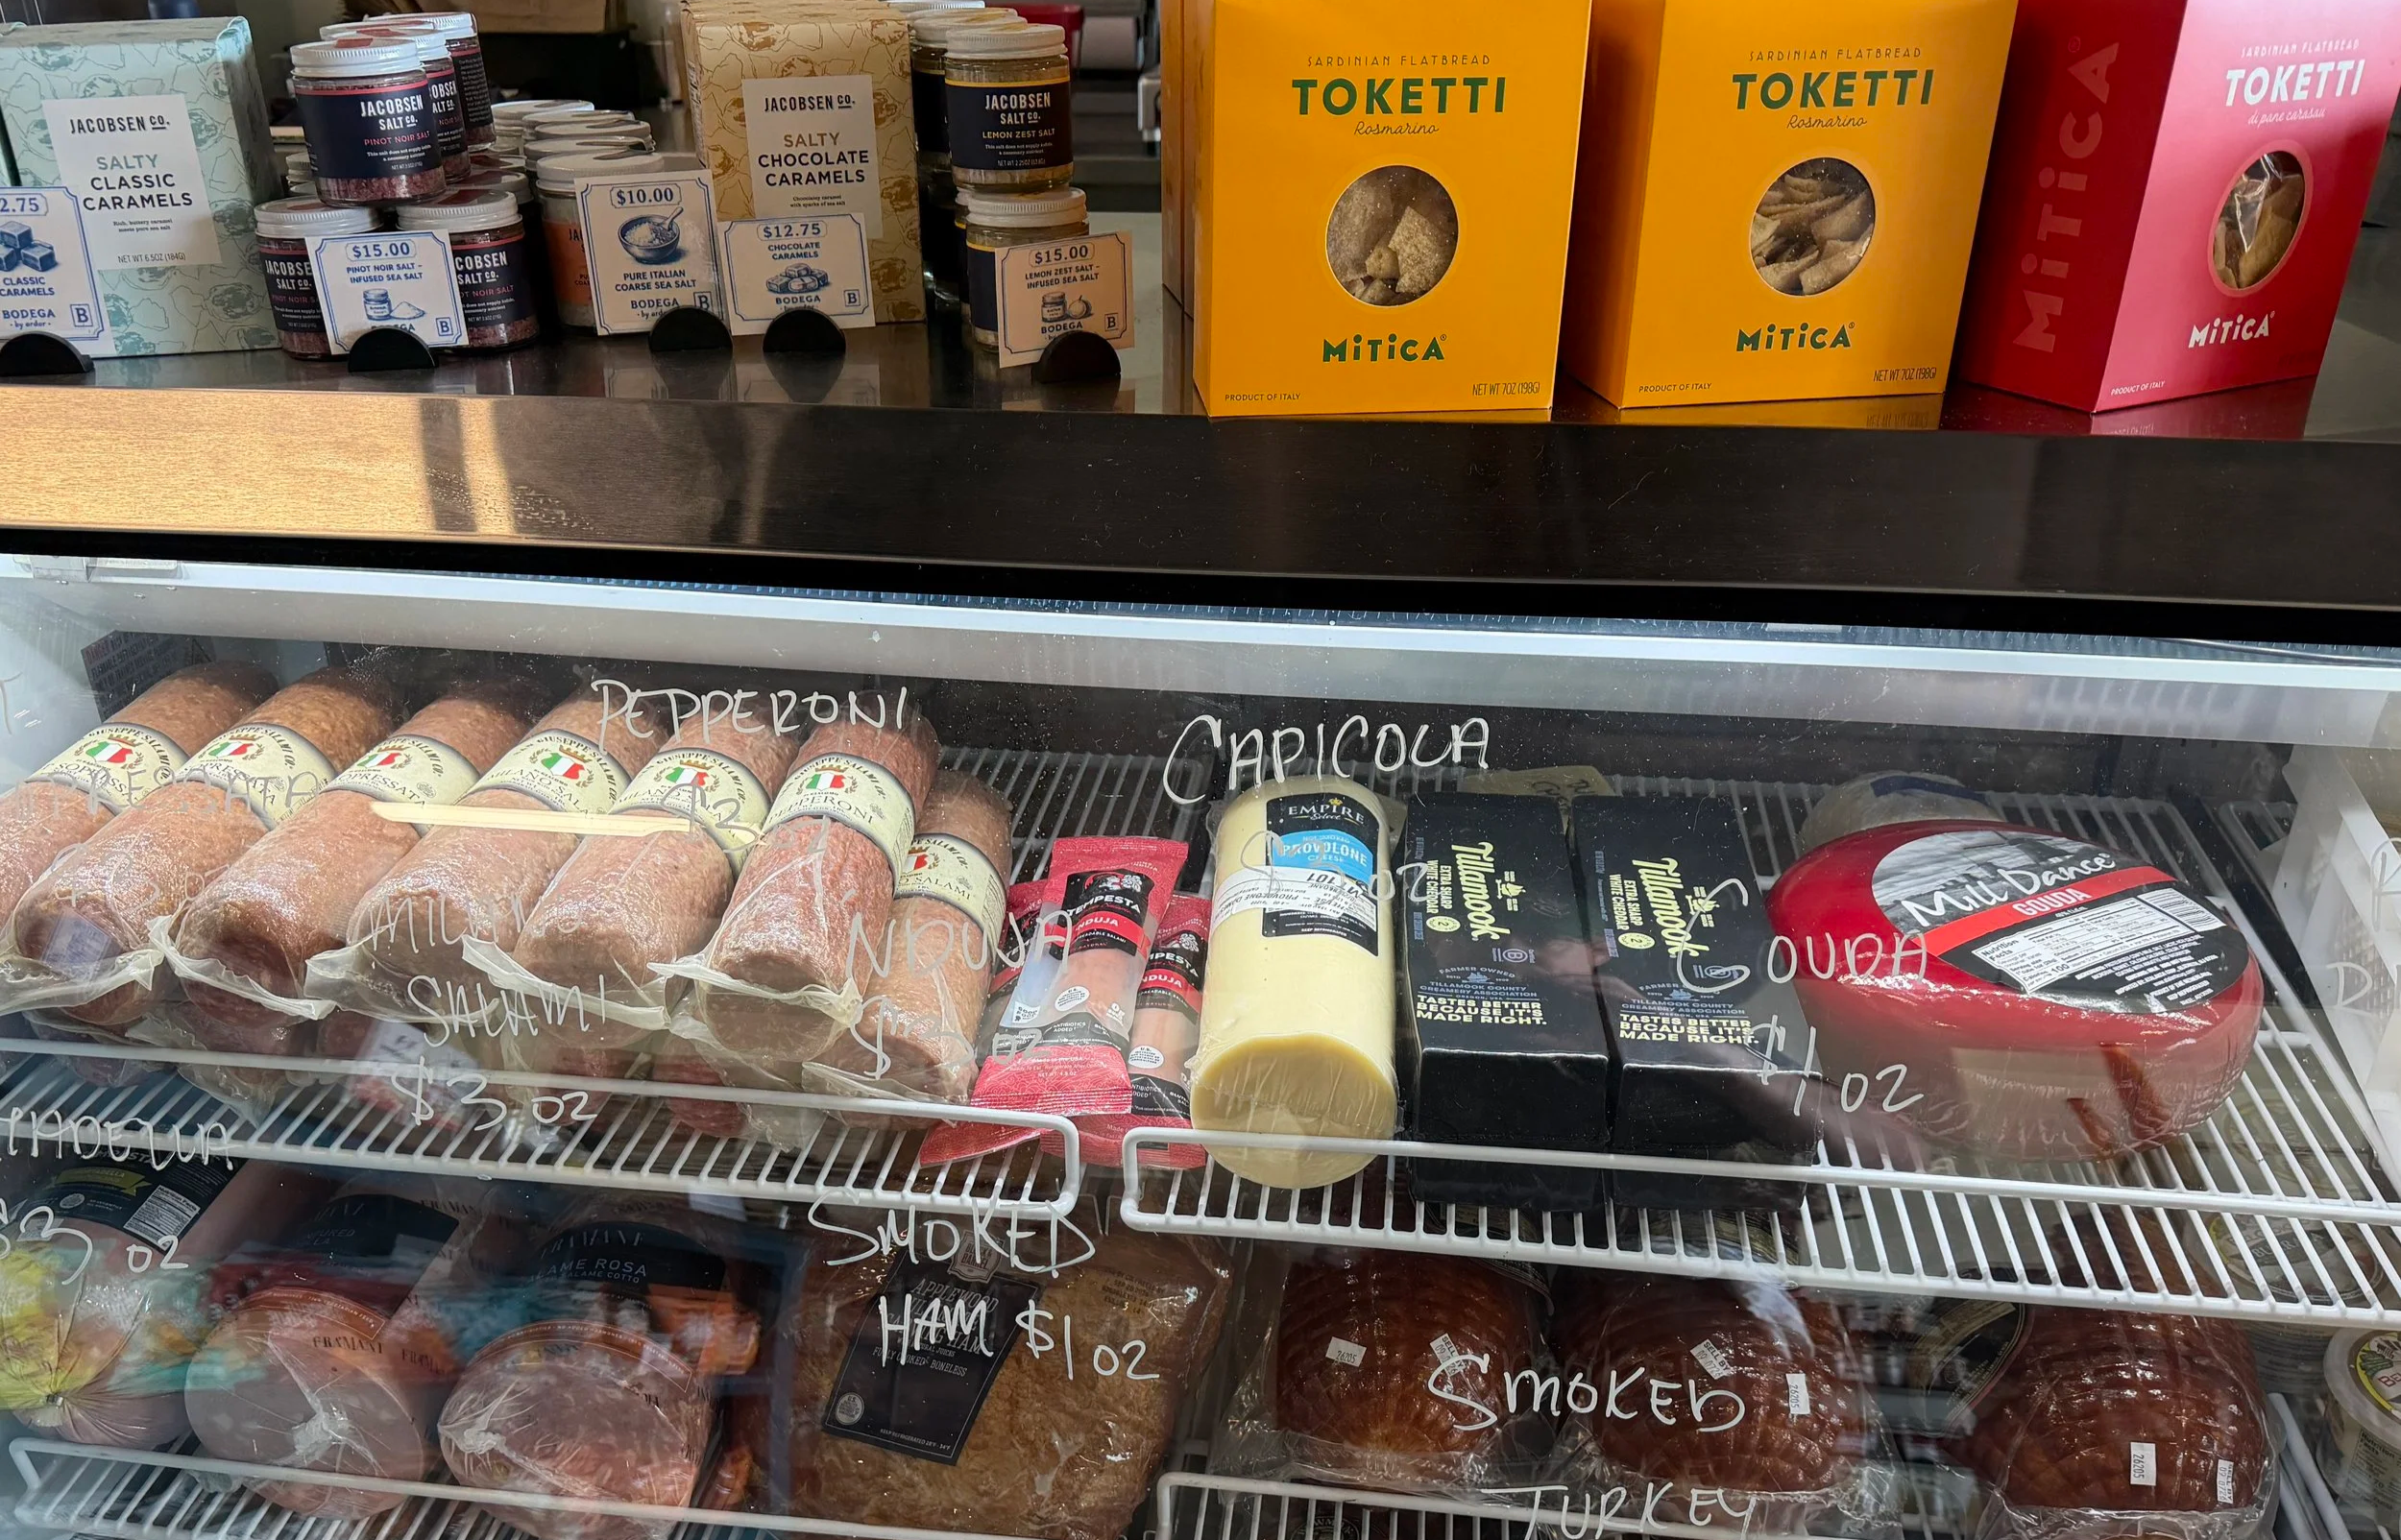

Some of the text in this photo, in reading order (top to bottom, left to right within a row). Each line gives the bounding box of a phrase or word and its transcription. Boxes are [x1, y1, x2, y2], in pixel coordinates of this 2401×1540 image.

[1749, 47, 1922, 62] SARDINIAN FLATBREAD
[2241, 43, 2297, 59] SARDINIAN
[1306, 54, 1491, 67] SARDINIAN FLATBREAD
[1732, 68, 1934, 111] TOKETTI
[2224, 59, 2365, 108] TOKETTI
[764, 95, 833, 112] JACOBSEN
[985, 92, 1051, 110] JACOBSEN
[1291, 77, 1507, 116] TOKETTI
[360, 95, 424, 117] JACOBSEN
[69, 116, 146, 134] JACOBSEN
[379, 116, 403, 131] SALT
[1001, 112, 1025, 125] SALT
[1786, 113, 1868, 130] Rosmarino
[1038, 128, 1055, 136] SALT
[1353, 120, 1440, 136] Rosmarino
[395, 134, 415, 144] NOIR
[417, 131, 430, 140] SALT
[784, 132, 840, 148] SALTY
[96, 154, 158, 171] SALTY
[758, 150, 869, 168] CHOCOLATE
[90, 174, 176, 191] CLASSIC
[765, 169, 865, 186] CARAMELS
[83, 192, 193, 211] CARAMELS
[617, 188, 674, 205] $10.00
[764, 223, 821, 238] $12.75
[352, 242, 411, 257] $15.00
[767, 242, 820, 252] CHOCOLATE
[771, 251, 819, 260] CARAMELS
[1034, 245, 1089, 265] $15.00
[346, 262, 416, 275] PINOT NOIR SALT
[623, 269, 686, 280] PURE ITALIAN
[1025, 263, 1093, 280] LEMON ZEST SALT
[3, 277, 46, 285] CLASSIC
[276, 278, 296, 290] SALT
[350, 272, 423, 284] INFUSED SEA SALT
[615, 279, 696, 292] COARSE SEA SALT
[1027, 273, 1099, 290] INFUSED SEA SALT
[0, 288, 55, 297] CARAMELS
[473, 285, 515, 298] NOIR SALT
[775, 295, 821, 305] BODEGA
[630, 299, 680, 309] BODEGA
[2, 309, 56, 319] BODEGA
[1040, 321, 1083, 334] BODEGA
[1638, 382, 1712, 394] PRODUCT ITALY
[2110, 381, 2166, 396] PRODUCT ITALY
[1225, 394, 1264, 402] PRODUCT
[591, 679, 909, 756] PEPPERONI
[536, 735, 592, 754] GIUSEPPE
[657, 753, 710, 764] GIUSEPPE
[1162, 714, 1491, 805] CAPICOLA
[768, 796, 872, 824] PEPPERONI
[1288, 805, 1365, 824] EMPIRE
[1310, 812, 1341, 821] Select
[1282, 842, 1368, 867] PROVOLONE
[1426, 859, 1439, 914] WHITE CHEDDAR
[1441, 865, 1452, 909] EXTRA SHARP
[1451, 841, 1511, 939] Tillamook
[1610, 874, 1623, 896] WHITE
[1066, 894, 1141, 917] TEMPESTA
[1624, 879, 1643, 926] EXTRA SHARP
[1632, 857, 1710, 957] Tillamook
[1901, 880, 2009, 928] Mill
[2012, 887, 2093, 917] GOUDA
[1612, 896, 1630, 930] CHEDDAR
[1677, 878, 1928, 993] GOUDA
[1980, 939, 2021, 957] Nutrition
[1439, 966, 1516, 978] FARMER OWNED
[1419, 985, 1471, 994] CREAMERY
[1429, 981, 1485, 990] TILLAMOOK
[1638, 982, 1679, 991] FARMER
[408, 974, 606, 1047] SALAMI
[1417, 995, 1541, 1009] TASTES BETTER
[1417, 1002, 1502, 1016] BECAUSE
[1621, 1003, 1676, 1012] CREAMERY
[1631, 999, 1690, 1007] TILLAMOOK
[1417, 1010, 1547, 1025] MADE RIGHT.
[1619, 1014, 1752, 1027] TASTES BETTER
[1619, 1022, 1710, 1035] BECAUSE
[1619, 1030, 1759, 1045] MADE RIGHT.
[807, 1187, 1097, 1279] SMOKED
[594, 1258, 647, 1278] ROSA
[606, 1271, 641, 1284] COTTO
[910, 1278, 1000, 1313] APPLEWOOD
[877, 1293, 994, 1367] HAM
[930, 1360, 968, 1377] BONELESS
[1428, 1354, 1746, 1433] SMOKED
[1790, 1384, 1799, 1408] 26205
[2133, 1454, 2145, 1479] 26205
[1480, 1481, 1759, 1540] TURKEY
